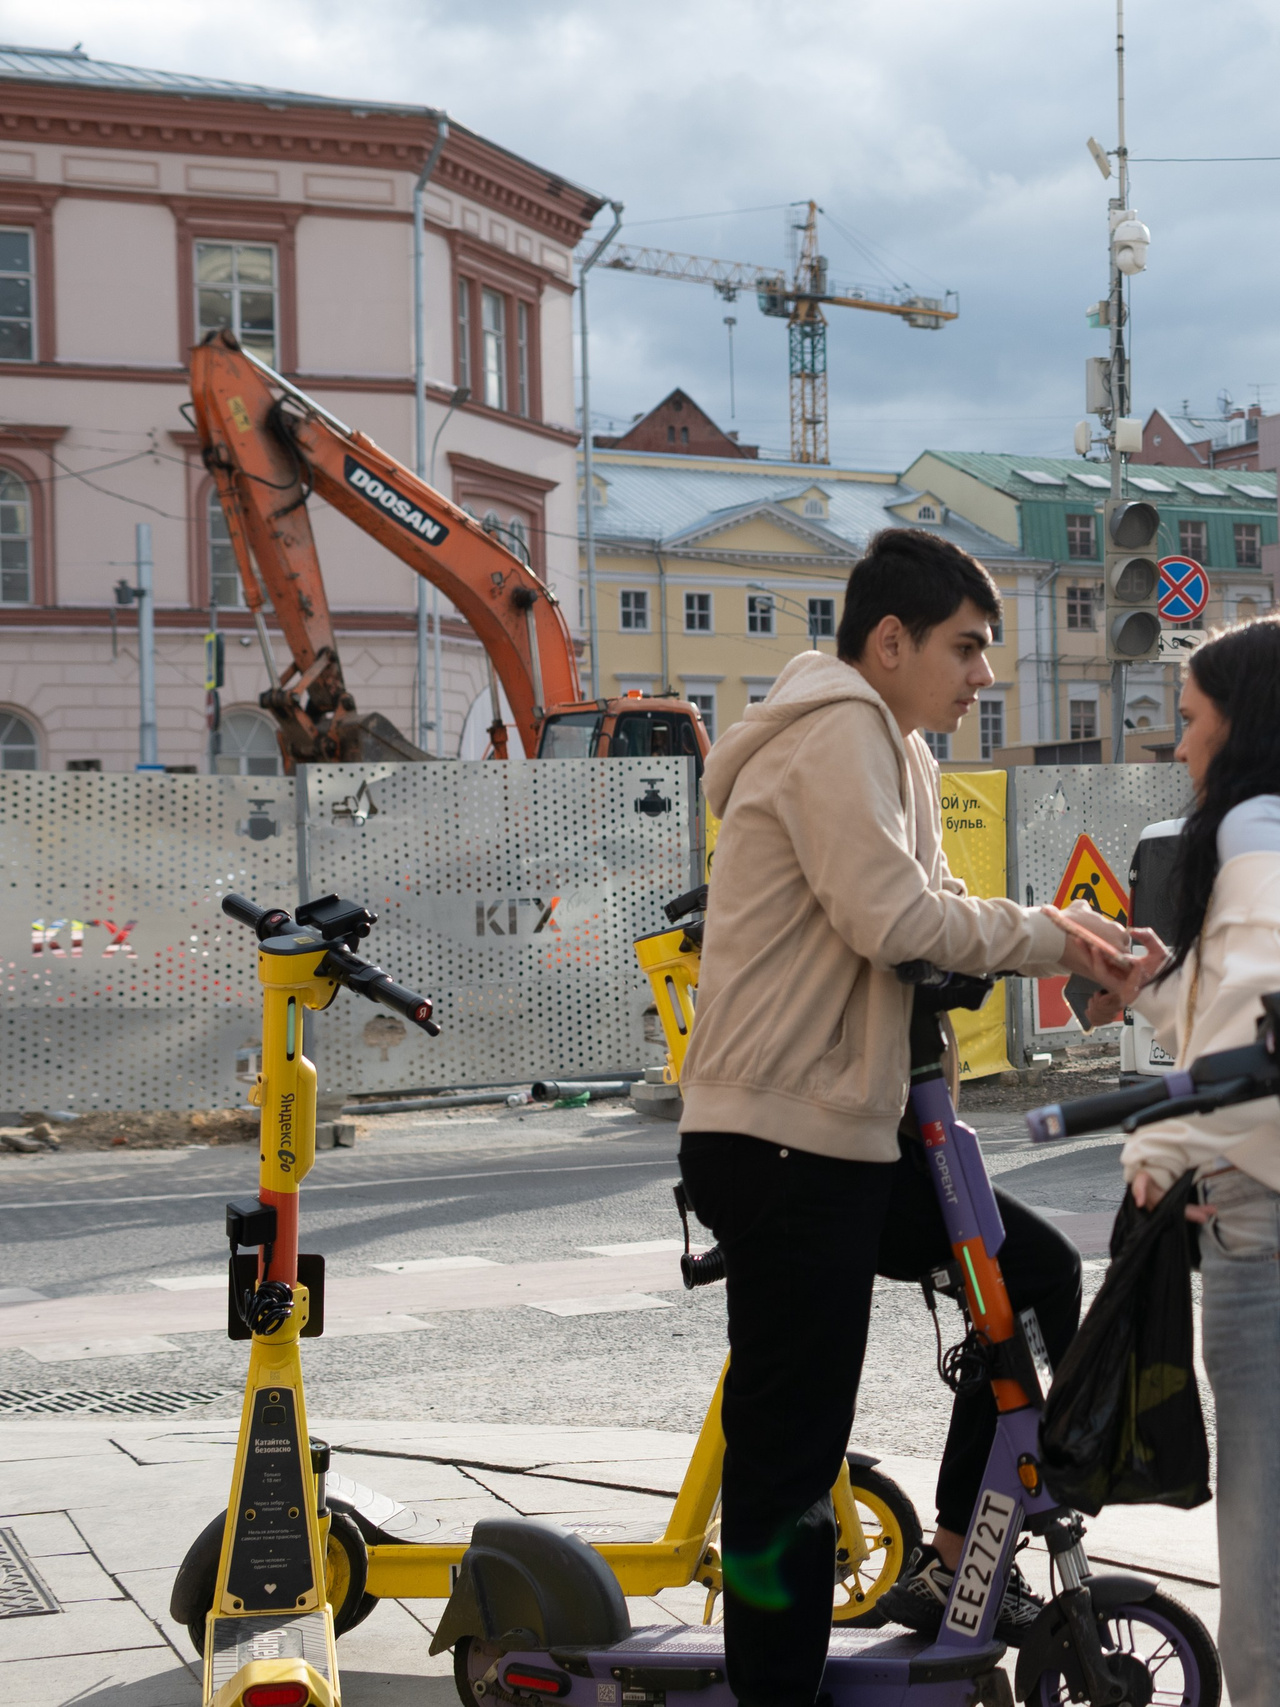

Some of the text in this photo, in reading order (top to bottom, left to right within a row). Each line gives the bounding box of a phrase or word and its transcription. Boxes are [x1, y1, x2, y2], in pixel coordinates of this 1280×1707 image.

[349, 468, 441, 540] DOOSAN
[941, 793, 981, 813] ОЙ ул.
[946, 816, 987, 833] бульв.
[476, 896, 561, 937] КГХ
[31, 918, 139, 958] КГХ
[277, 1093, 296, 1173] Яндекс Go
[934, 1150, 958, 1205] ЮРЕНТ
[254, 1438, 291, 1447] Катайтесь
[254, 1446, 292, 1454] безопасно
[951, 1495, 1010, 1631] ЕЕ272Т
